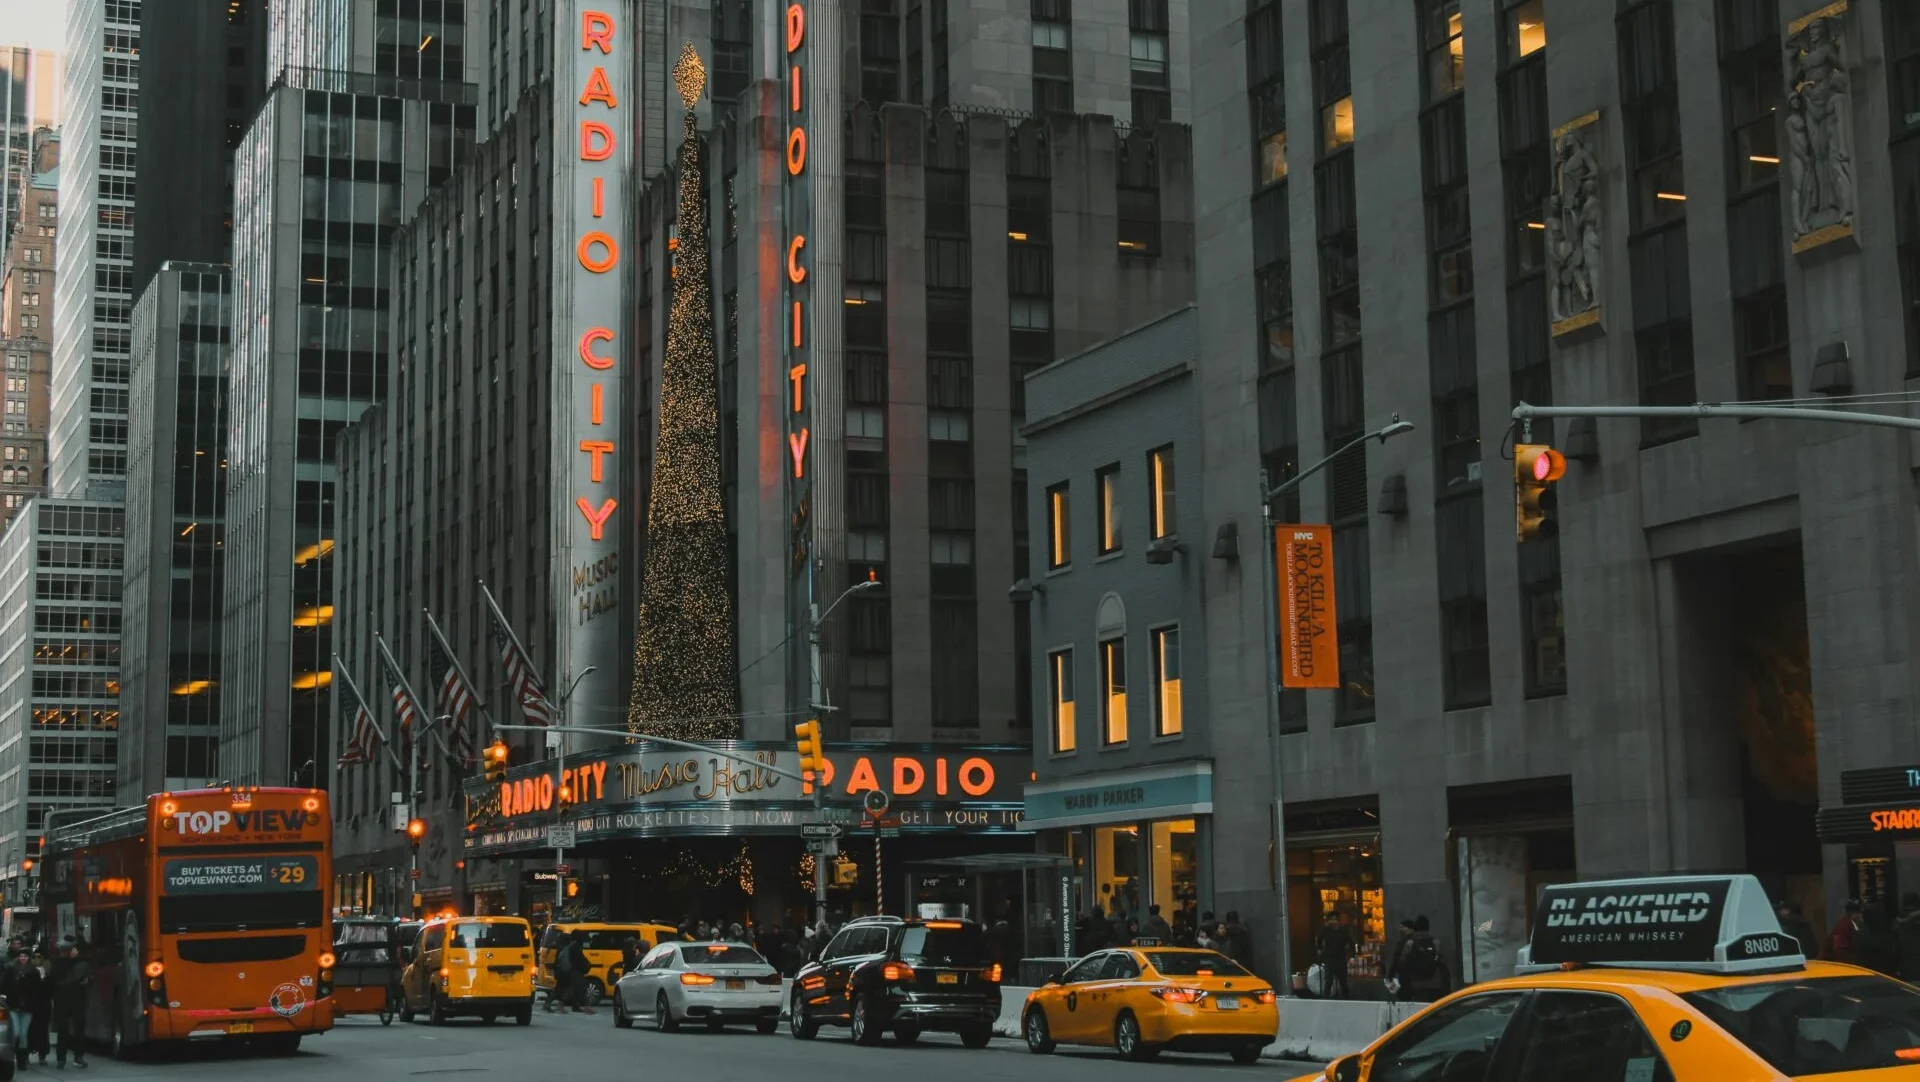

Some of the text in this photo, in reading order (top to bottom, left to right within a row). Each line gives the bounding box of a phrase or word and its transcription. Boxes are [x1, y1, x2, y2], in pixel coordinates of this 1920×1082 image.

[577, 11, 618, 540] RADIO CITY
[787, 234, 808, 479] CITY
[1294, 532, 1313, 540] NYC
[573, 552, 618, 597] MUSIC
[1309, 543, 1325, 639] TO KILL A
[579, 594, 618, 627] HALL
[1294, 543, 1314, 679] MOCKINGBIRD
[501, 774, 553, 818] RADIO
[616, 759, 700, 801] Music
[693, 750, 781, 801] Hall
[232, 793, 252, 803] 334
[1064, 787, 1145, 811] WARBY PARKER
[173, 809, 307, 834] TOP VIEW
[616, 811, 710, 828] ROCKETTES
[755, 811, 794, 825] NOW
[900, 811, 931, 824] GET
[945, 811, 989, 824] YOUR
[170, 874, 263, 886] TOPVIEWNYC.COM
[181, 865, 262, 877] BUY TICKETS AT
[534, 873, 558, 881] Subway
[1547, 892, 1710, 927] BLACKENED
[1560, 931, 1684, 944] AMERICAN WHISKEY
[1744, 937, 1779, 955] 8N80
